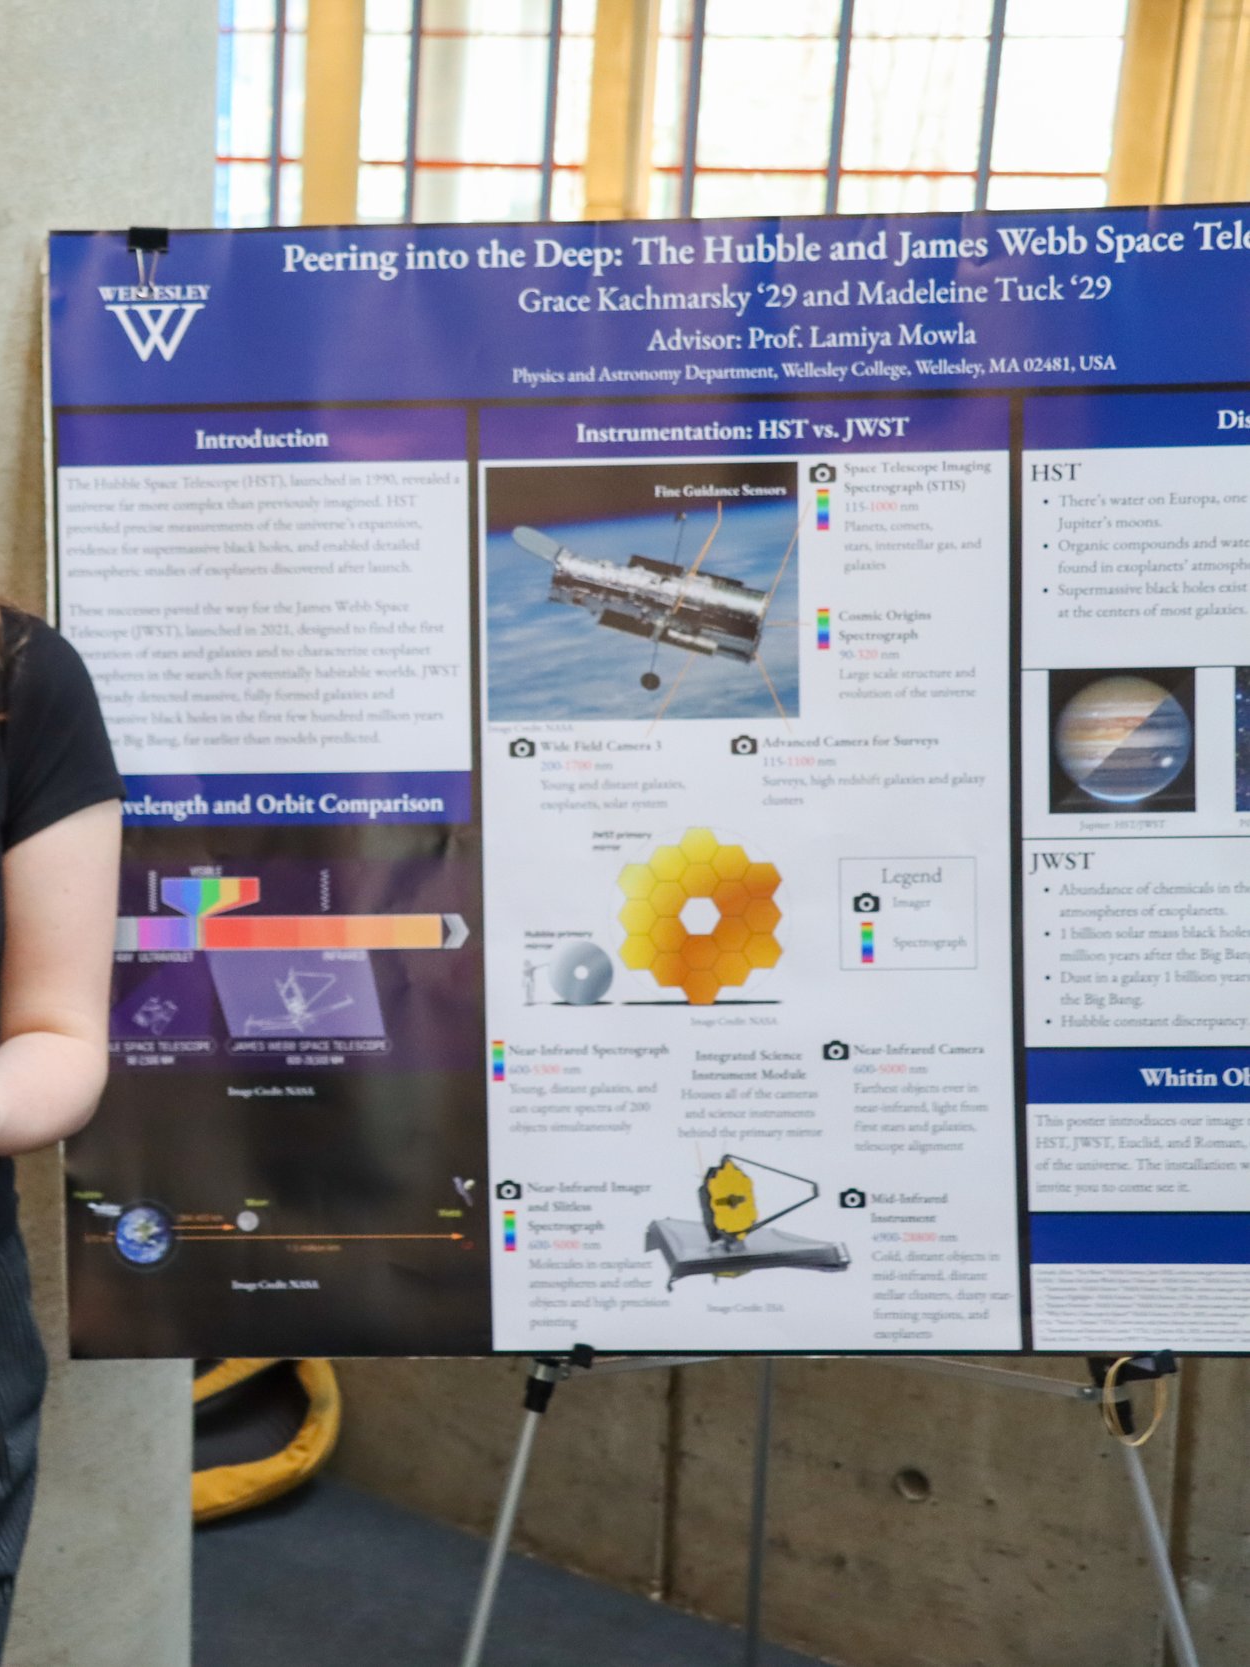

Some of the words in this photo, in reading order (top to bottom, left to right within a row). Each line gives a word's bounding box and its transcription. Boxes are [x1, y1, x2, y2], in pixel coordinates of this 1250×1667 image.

[283, 243, 399, 283] Peering
[406, 242, 468, 270] into
[478, 239, 526, 269] the
[535, 239, 621, 277] Deep:
[632, 235, 695, 266] The
[705, 232, 821, 264] Hubble
[830, 230, 889, 262] and
[895, 230, 988, 267] James
[997, 225, 1087, 257] Webb
[1097, 224, 1184, 264] Space
[520, 288, 591, 313] Grace
[598, 283, 752, 320] Kachmarsky
[804, 281, 851, 307] and
[858, 277, 987, 306] Madeleine
[996, 275, 1065, 302] Tuck
[104, 303, 206, 362] W
[647, 327, 742, 351] Advisor:
[749, 326, 804, 349] Prof.
[811, 325, 893, 356] Lamiya
[899, 322, 976, 346] Mowla
[512, 367, 564, 388] Physics
[568, 367, 596, 382] and
[599, 366, 681, 387] Astronomy
[685, 364, 778, 384] Department,
[782, 362, 849, 383] Wellesley
[852, 360, 910, 382] College,
[914, 358, 986, 380] Wellesley,
[990, 358, 1021, 373] MA
[1024, 357, 1076, 375] 02481,
[1080, 355, 1117, 371] USA
[1217, 409, 1250, 430] Dis
[196, 427, 329, 450] Introduction
[576, 421, 752, 443] Instrumentation:
[759, 419, 808, 439] HST
[813, 425, 839, 439] vs.
[843, 417, 909, 442] JWST
[844, 462, 878, 478] Space
[881, 460, 939, 477] Telescope
[941, 460, 992, 476] Imaging
[1031, 463, 1082, 482] HST
[655, 486, 681, 498] Fine
[684, 484, 740, 497] Guidance
[742, 484, 787, 496] Sensors
[844, 480, 924, 497] Spectrograph
[927, 479, 966, 495] (STIS)
[1109, 496, 1146, 506] water
[1149, 496, 1166, 506] on
[1169, 492, 1220, 509] Europa,
[1224, 495, 1247, 504] one
[1116, 519, 1163, 529] moons.
[1058, 538, 1110, 556] Organic
[1114, 536, 1190, 555] compounds
[1193, 536, 1218, 549] and
[1058, 582, 1143, 601] Supermassive
[1146, 581, 1181, 595] black
[1183, 580, 1216, 594] holes
[1219, 581, 1248, 593] exist
[839, 610, 883, 622] Cosmic
[886, 609, 932, 625] Origins
[1058, 609, 1070, 619] at
[1073, 605, 1093, 618] the
[1096, 608, 1141, 618] centers
[1144, 604, 1160, 617] of
[1161, 607, 1193, 617] most
[1196, 602, 1247, 620] galaxies.
[839, 628, 919, 645] Spectrograph
[540, 741, 572, 752] Wide
[574, 740, 604, 752] Field
[606, 740, 652, 752] Camera
[655, 741, 662, 751] 3
[762, 736, 821, 748] Advanced
[824, 736, 870, 748] Camera
[873, 735, 891, 747] for
[894, 735, 939, 750] Surveys
[122, 794, 209, 822] velength
[214, 794, 252, 814] and
[257, 794, 315, 814] Orbit
[321, 793, 444, 819] Comparison
[1029, 852, 1096, 875] JWST
[881, 867, 943, 890] Legend
[894, 936, 967, 952] Spectrograph
[508, 1044, 590, 1056] Near-Infrared
[592, 1044, 670, 1059] Spectrograph
[695, 1050, 757, 1065] Integrated
[760, 1050, 802, 1061] Science
[854, 1044, 936, 1056] Near-Infrared
[939, 1044, 984, 1055] Camera
[692, 1070, 759, 1081] Instrument
[761, 1068, 806, 1080] Module
[1139, 1067, 1218, 1087] Whitin
[871, 1193, 948, 1204] Mid-Infrared
[871, 1213, 936, 1223] Instrument
[528, 1220, 605, 1235] Spectrograph
